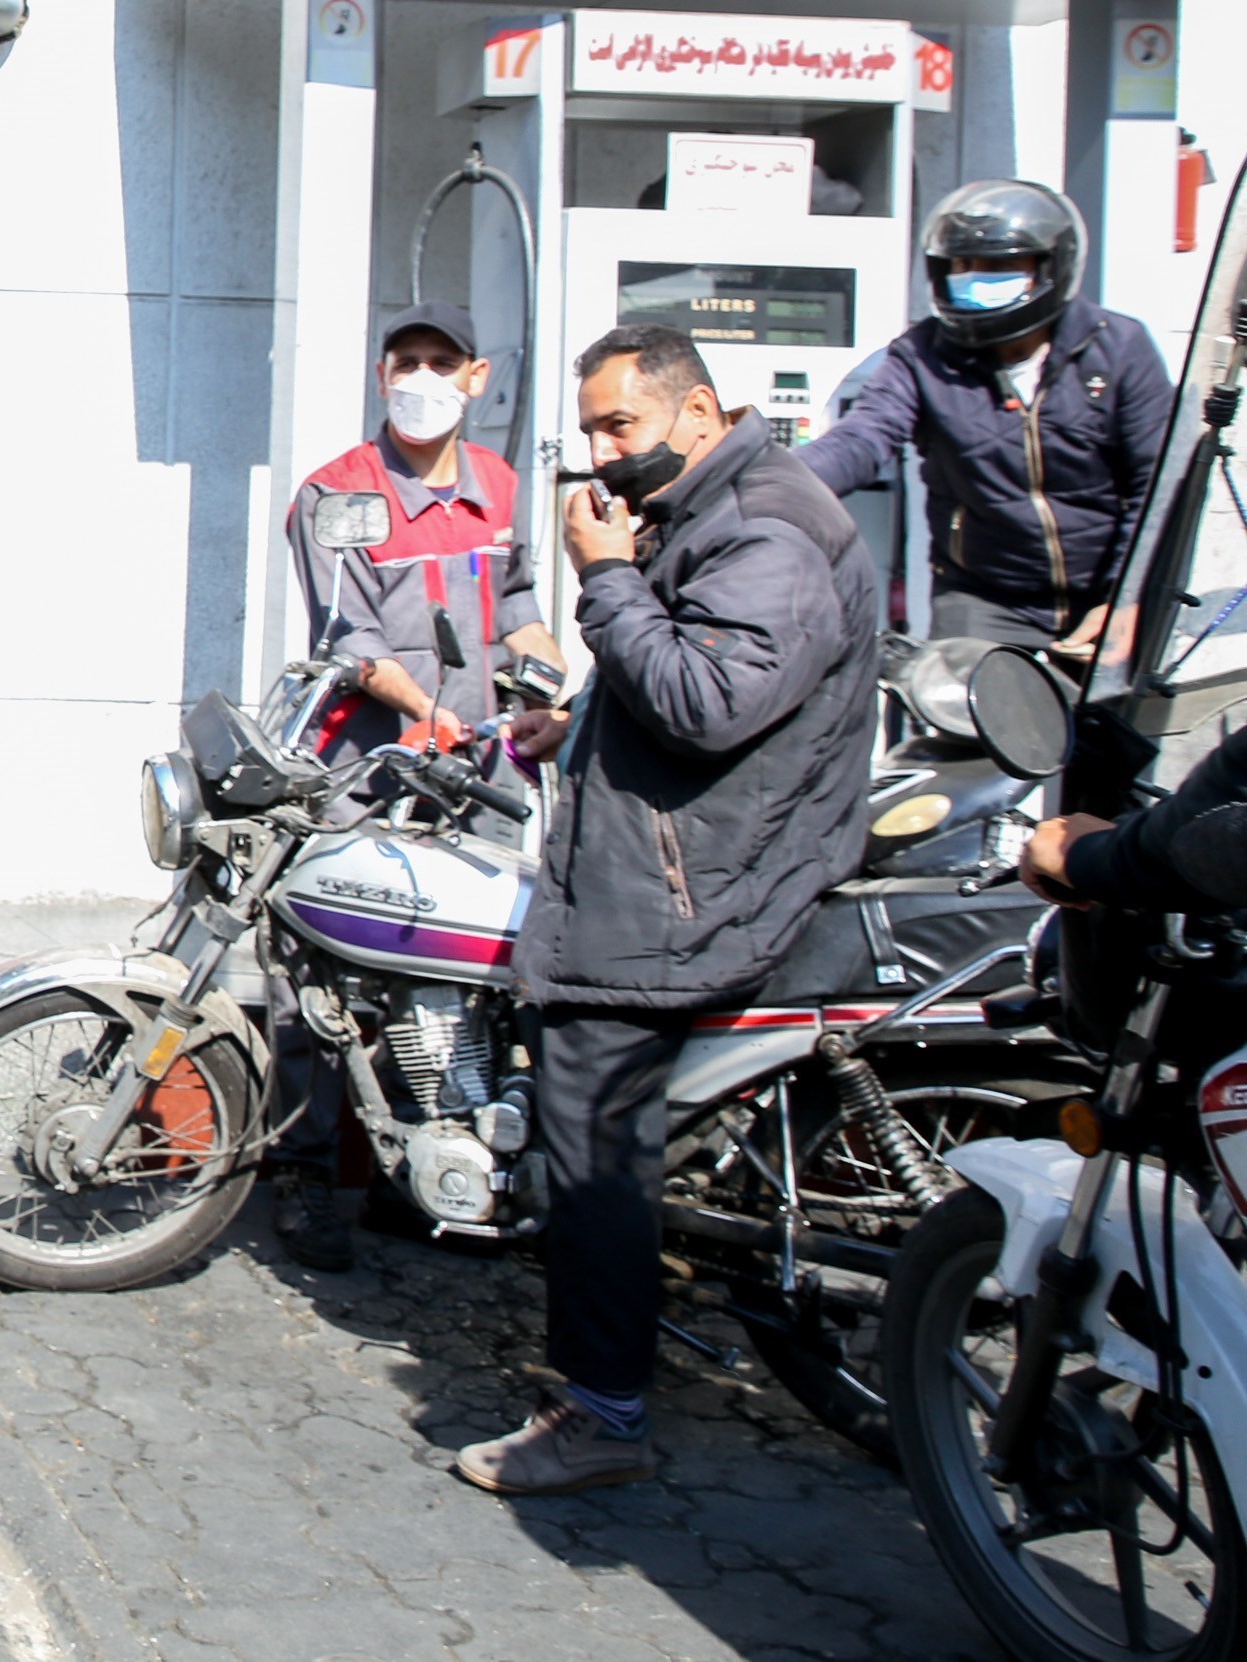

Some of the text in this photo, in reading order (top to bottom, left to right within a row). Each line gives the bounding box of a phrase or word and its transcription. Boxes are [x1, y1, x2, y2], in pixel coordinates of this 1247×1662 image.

[484, 29, 541, 78] 17
[589, 33, 614, 61] است
[914, 42, 953, 92] 18
[690, 297, 756, 313] LITERS
